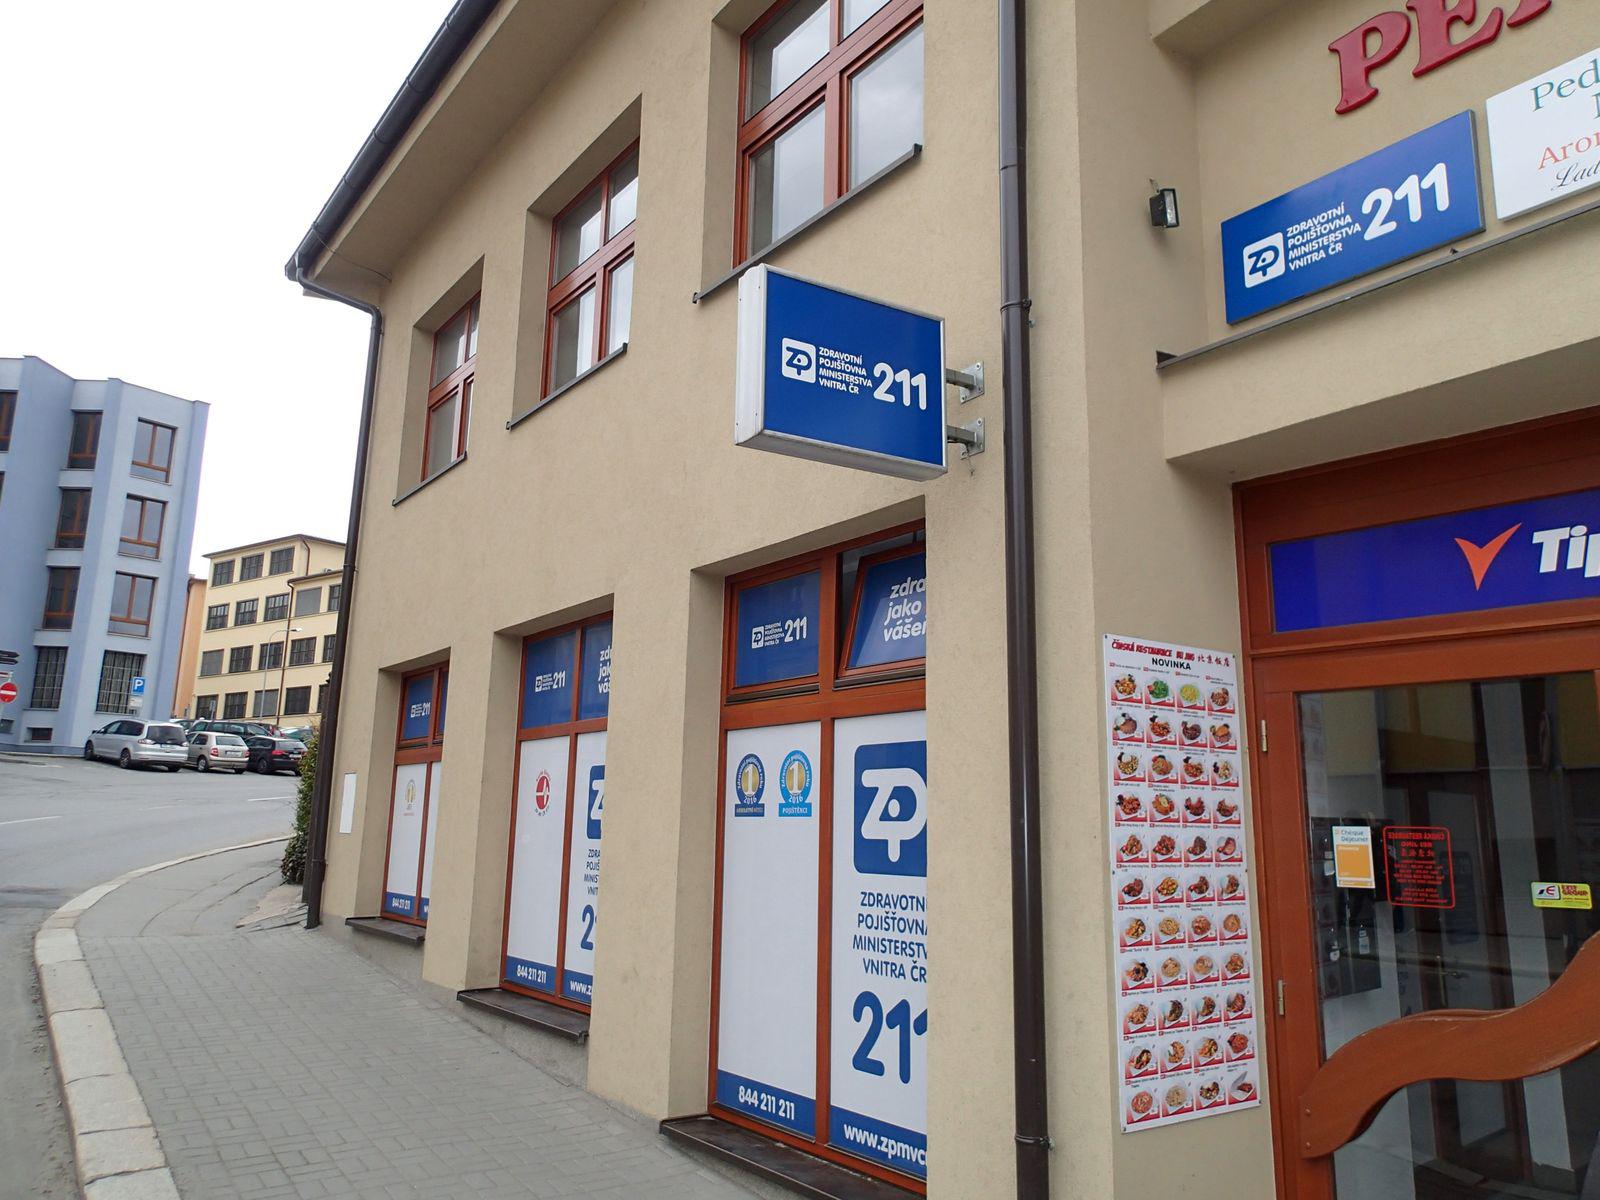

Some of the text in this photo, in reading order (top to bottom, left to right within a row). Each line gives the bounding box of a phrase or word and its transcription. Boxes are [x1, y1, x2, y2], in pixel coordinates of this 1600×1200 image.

[1361, 162, 1450, 241] 211
[1286, 201, 1345, 237] ZDRAVOTNÍ
[1288, 214, 1353, 249] POJIŠŤOVNA
[1288, 222, 1362, 260] MINISTERSTVA
[1289, 241, 1343, 271] VNITRA ČR
[819, 346, 863, 366] ZDRAVOTNÍ
[819, 356, 867, 377] POJIŠŤOVNA
[819, 367, 873, 388] MINISTERSTVA
[819, 377, 859, 395] VNITRA ČR
[873, 362, 927, 411] 211
[884, 598, 922, 626] jako
[784, 616, 807, 643] 211
[600, 645, 612, 661] zd
[1151, 657, 1192, 671] NOVINKA
[134, 679, 143, 690] P
[552, 670, 566, 689] 211
[744, 796, 758, 805] 2016
[788, 794, 804, 804] 2016
[580, 904, 597, 951] 2
[516, 964, 547, 983] 844 211 211
[862, 957, 927, 984] VNITRA ČR
[738, 1085, 795, 1120] 844 211 211
[843, 1123, 927, 1166] www.zpmvc
